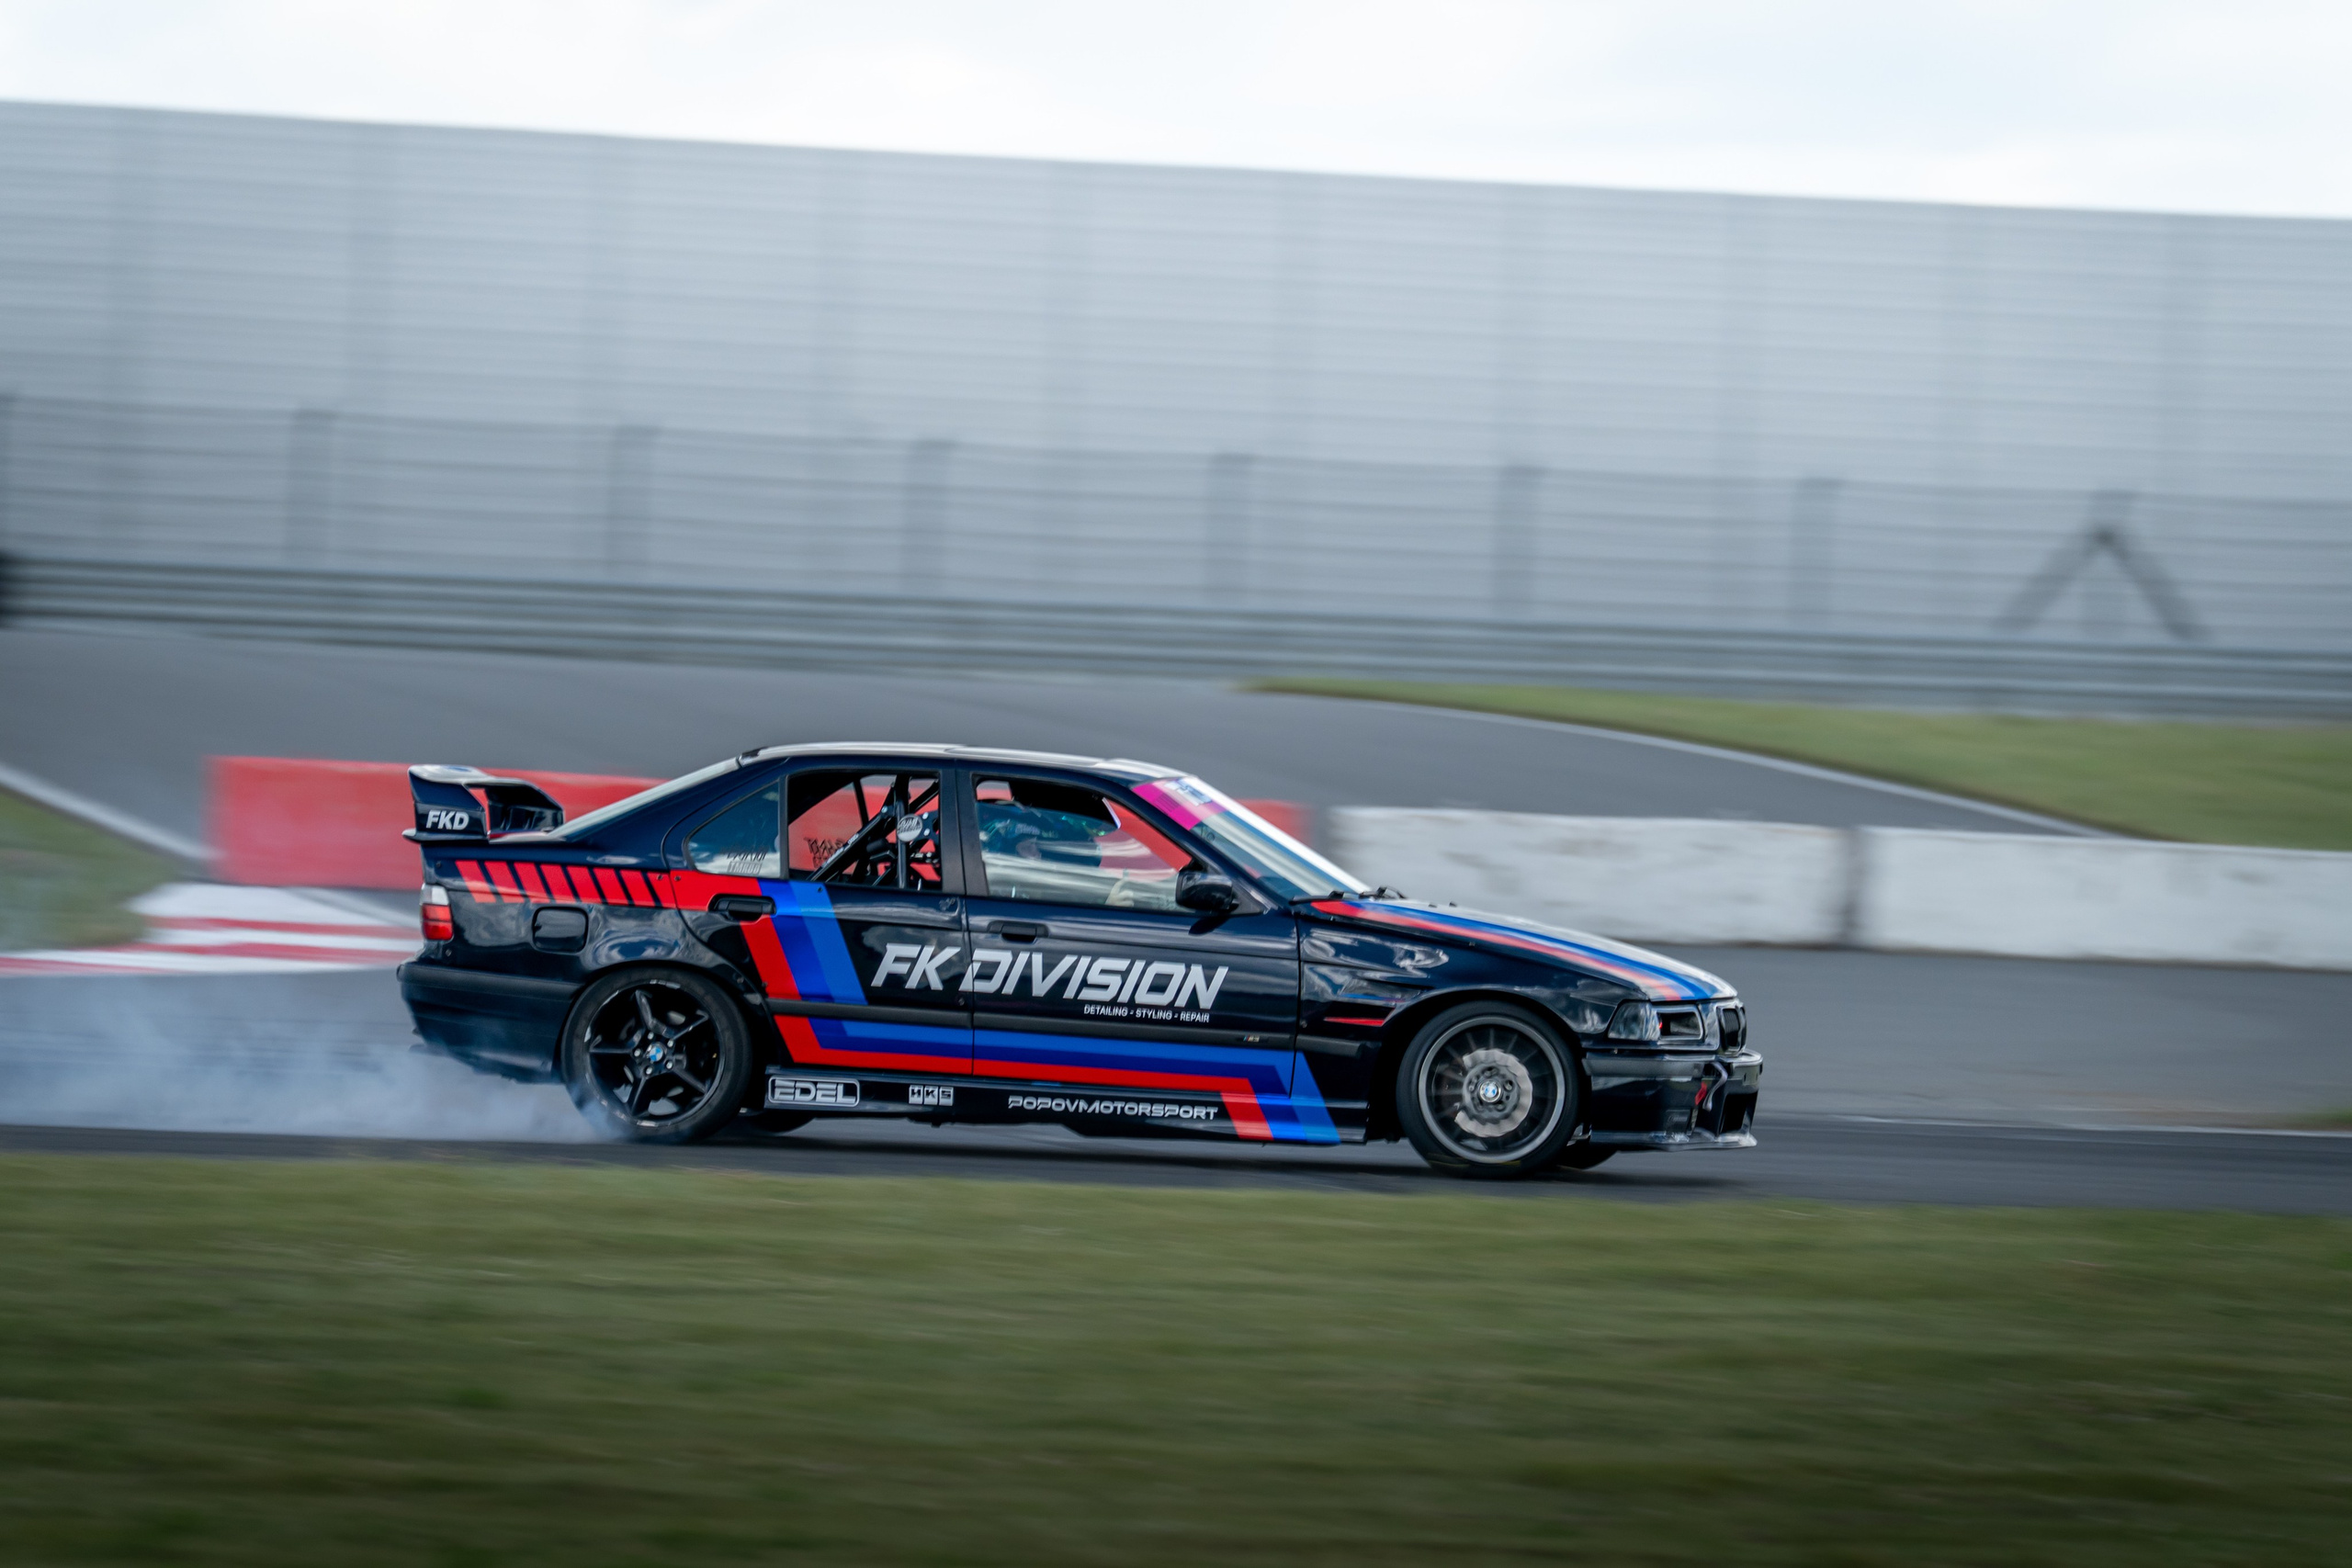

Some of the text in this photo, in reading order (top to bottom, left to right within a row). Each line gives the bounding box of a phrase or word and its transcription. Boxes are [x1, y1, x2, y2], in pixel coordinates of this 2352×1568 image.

[425, 809, 469, 830] FKD
[870, 942, 1229, 1010] FK DIVISION
[1083, 1003, 1128, 1017] DETAILING
[1136, 1007, 1173, 1021] STYLING
[1180, 1010, 1210, 1023] REPAIR
[774, 1077, 856, 1103] EDEL
